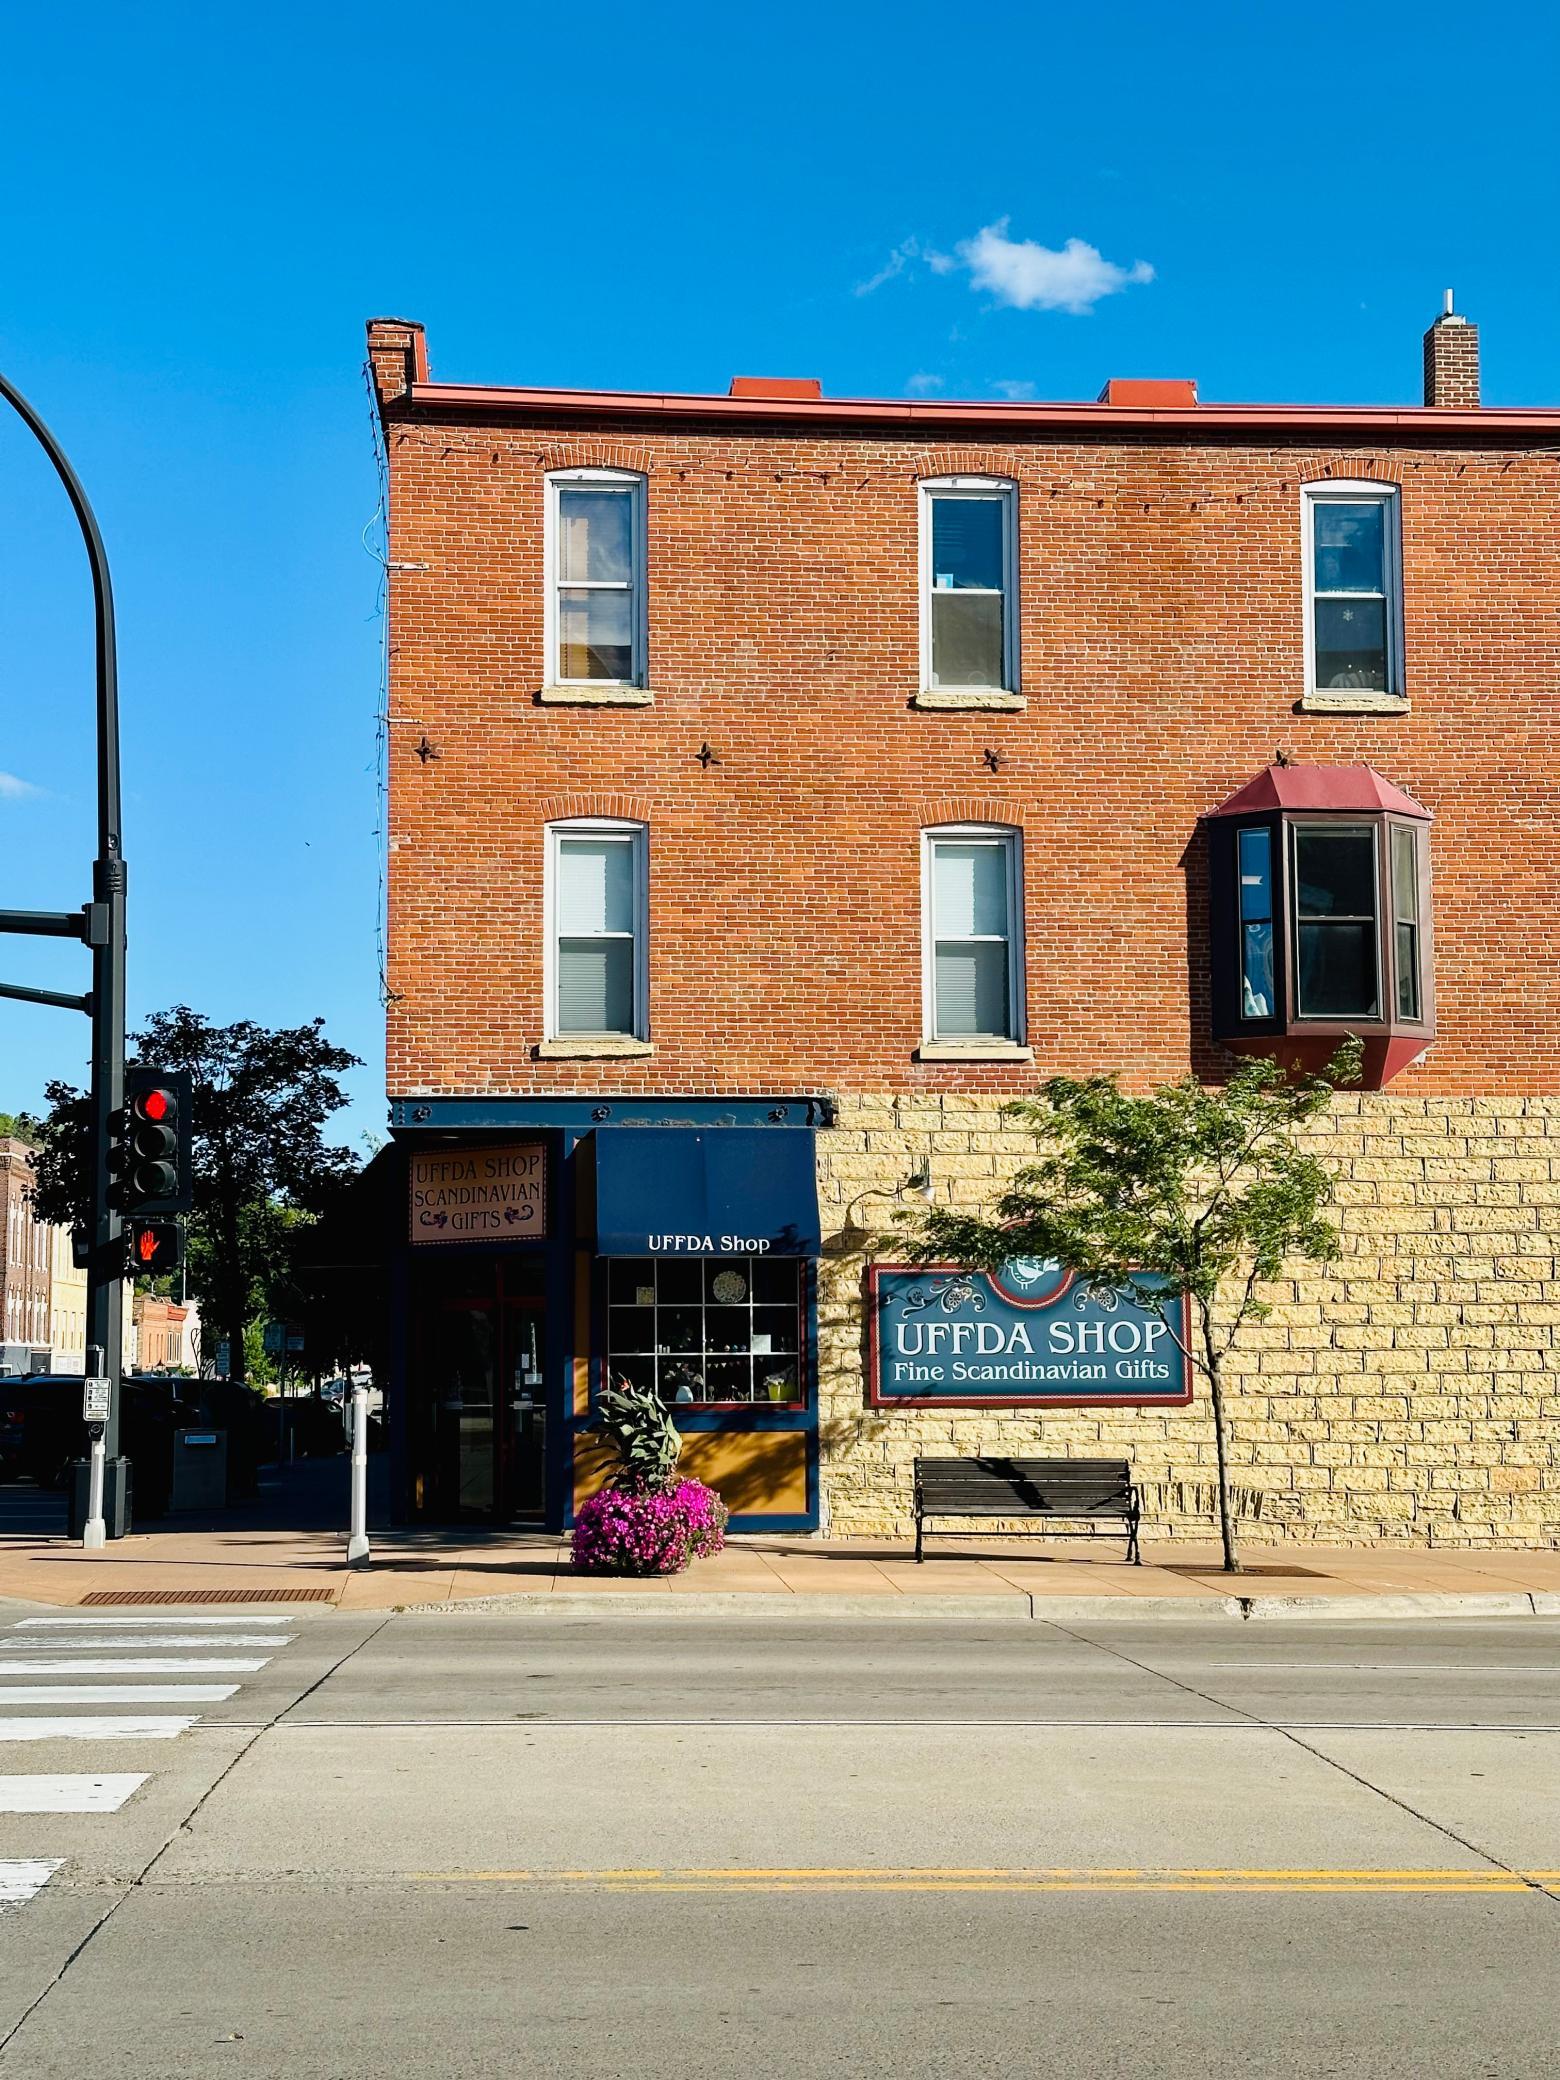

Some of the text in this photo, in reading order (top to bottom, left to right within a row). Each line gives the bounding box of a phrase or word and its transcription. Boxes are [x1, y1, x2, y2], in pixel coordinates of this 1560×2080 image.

[416, 1154, 540, 1183] UFFDA SHOP
[414, 1182, 540, 1207] SCANDINAVIAN
[451, 1210, 501, 1230] GIFTS
[648, 1234, 770, 1255] UFFDA Shop
[895, 1320, 1169, 1356] UFFDA SHOP
[894, 1359, 1171, 1382] Fine Scandinavian Gifts
